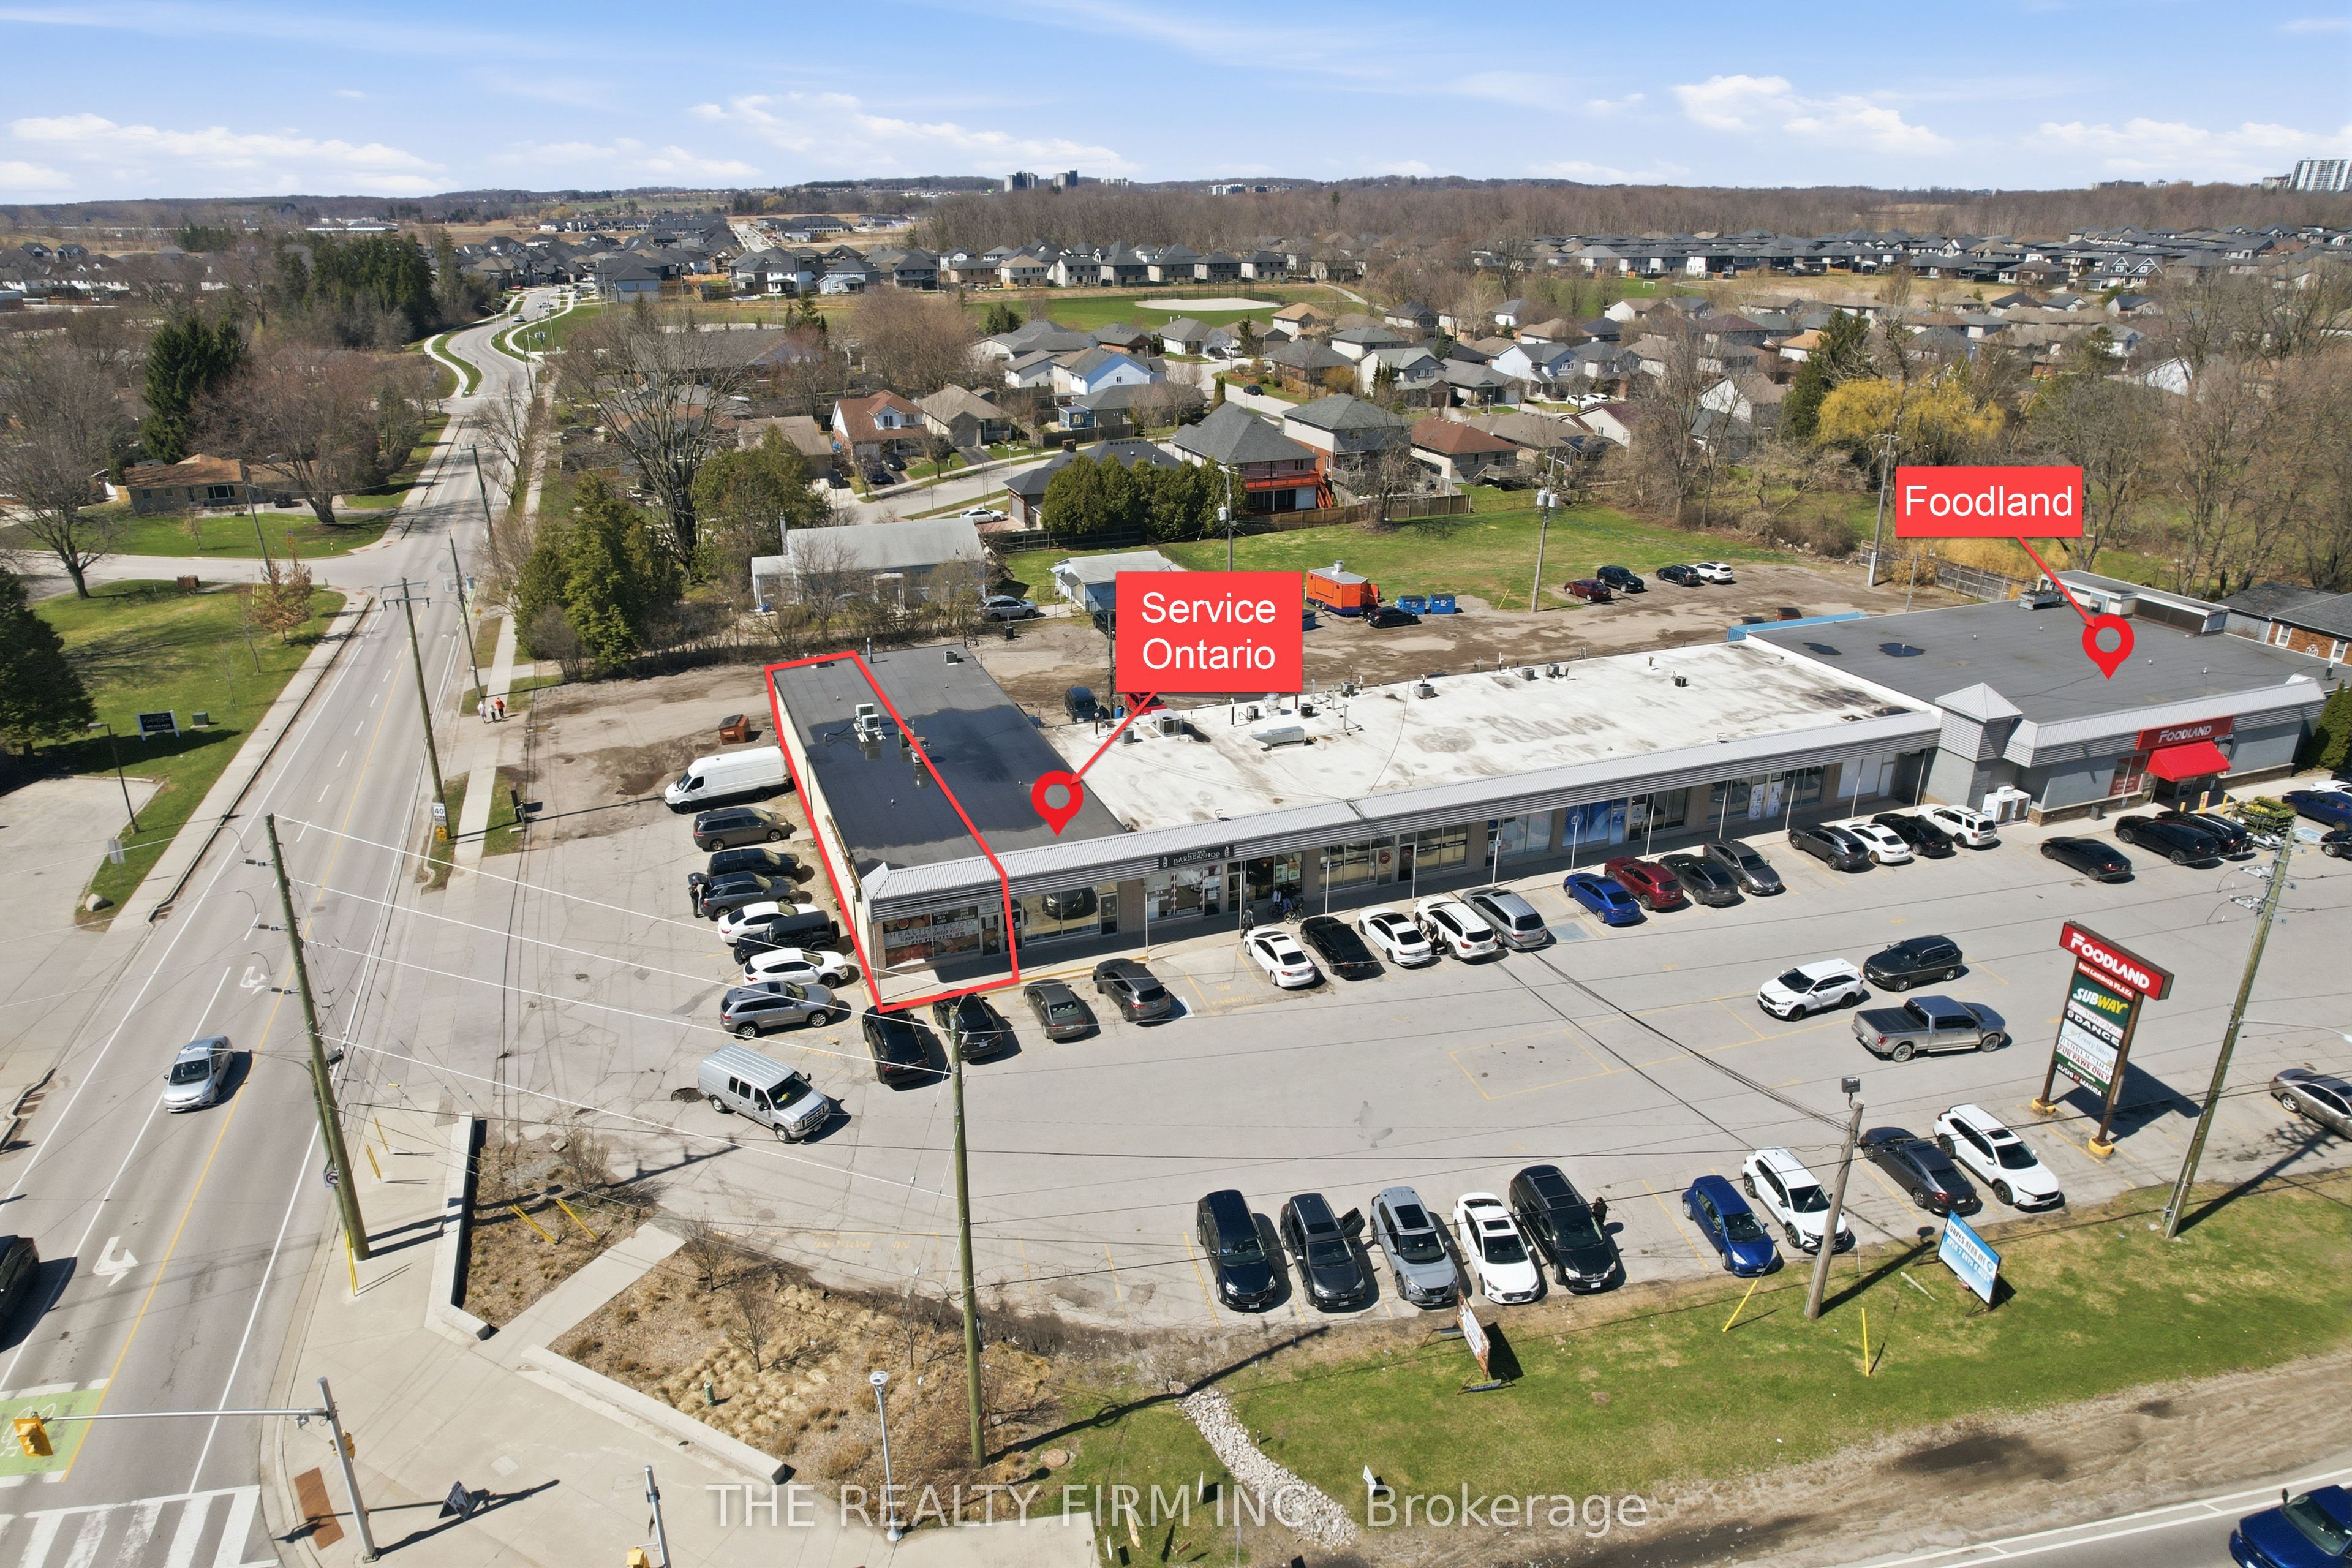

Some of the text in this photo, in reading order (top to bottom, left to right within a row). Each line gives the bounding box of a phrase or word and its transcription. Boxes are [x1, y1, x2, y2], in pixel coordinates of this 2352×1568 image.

[2158, 725, 2212, 744] FOODLAND
[889, 925, 938, 939] HEALTHY
[944, 920, 973, 931] FOOD
[2070, 932, 2150, 989] FOODLAND
[2073, 987, 2129, 1015] SUBWAY
[2074, 1013, 2120, 1047] DANCE
[2092, 1066, 2110, 1082] ONLY
